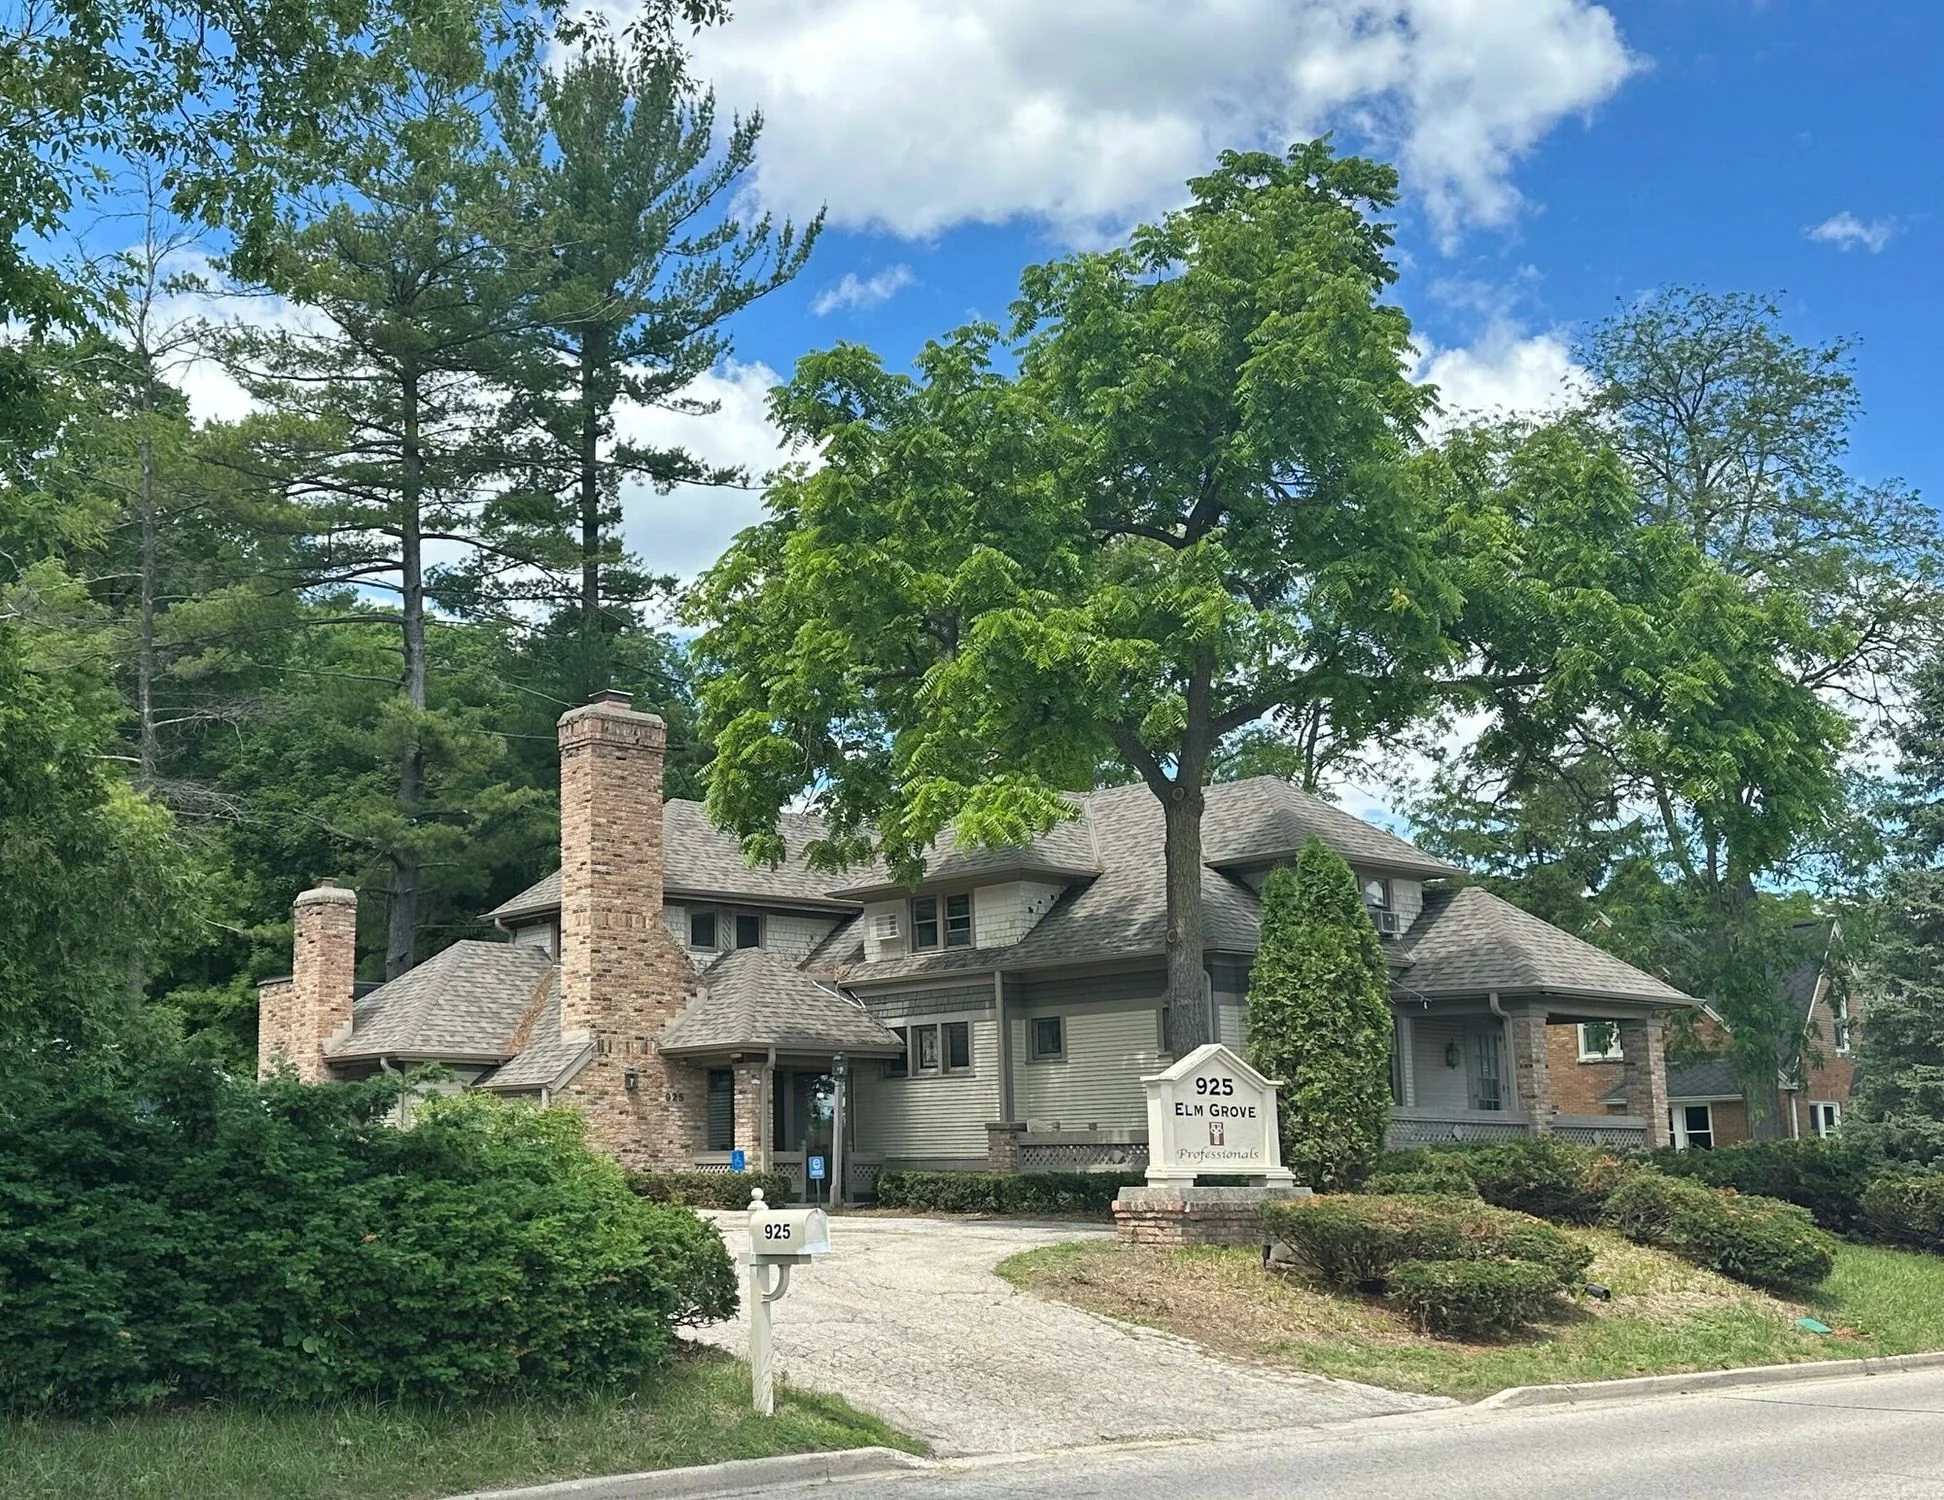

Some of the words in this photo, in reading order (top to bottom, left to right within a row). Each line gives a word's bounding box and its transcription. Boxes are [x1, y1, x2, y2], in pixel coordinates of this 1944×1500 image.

[1195, 1077, 1234, 1096] 925
[665, 1092, 684, 1102] 925
[1175, 1102, 1204, 1117] ELM
[1209, 1103, 1257, 1118] GROVE
[1176, 1146, 1259, 1164] Professionals
[764, 1223, 791, 1240] 925
